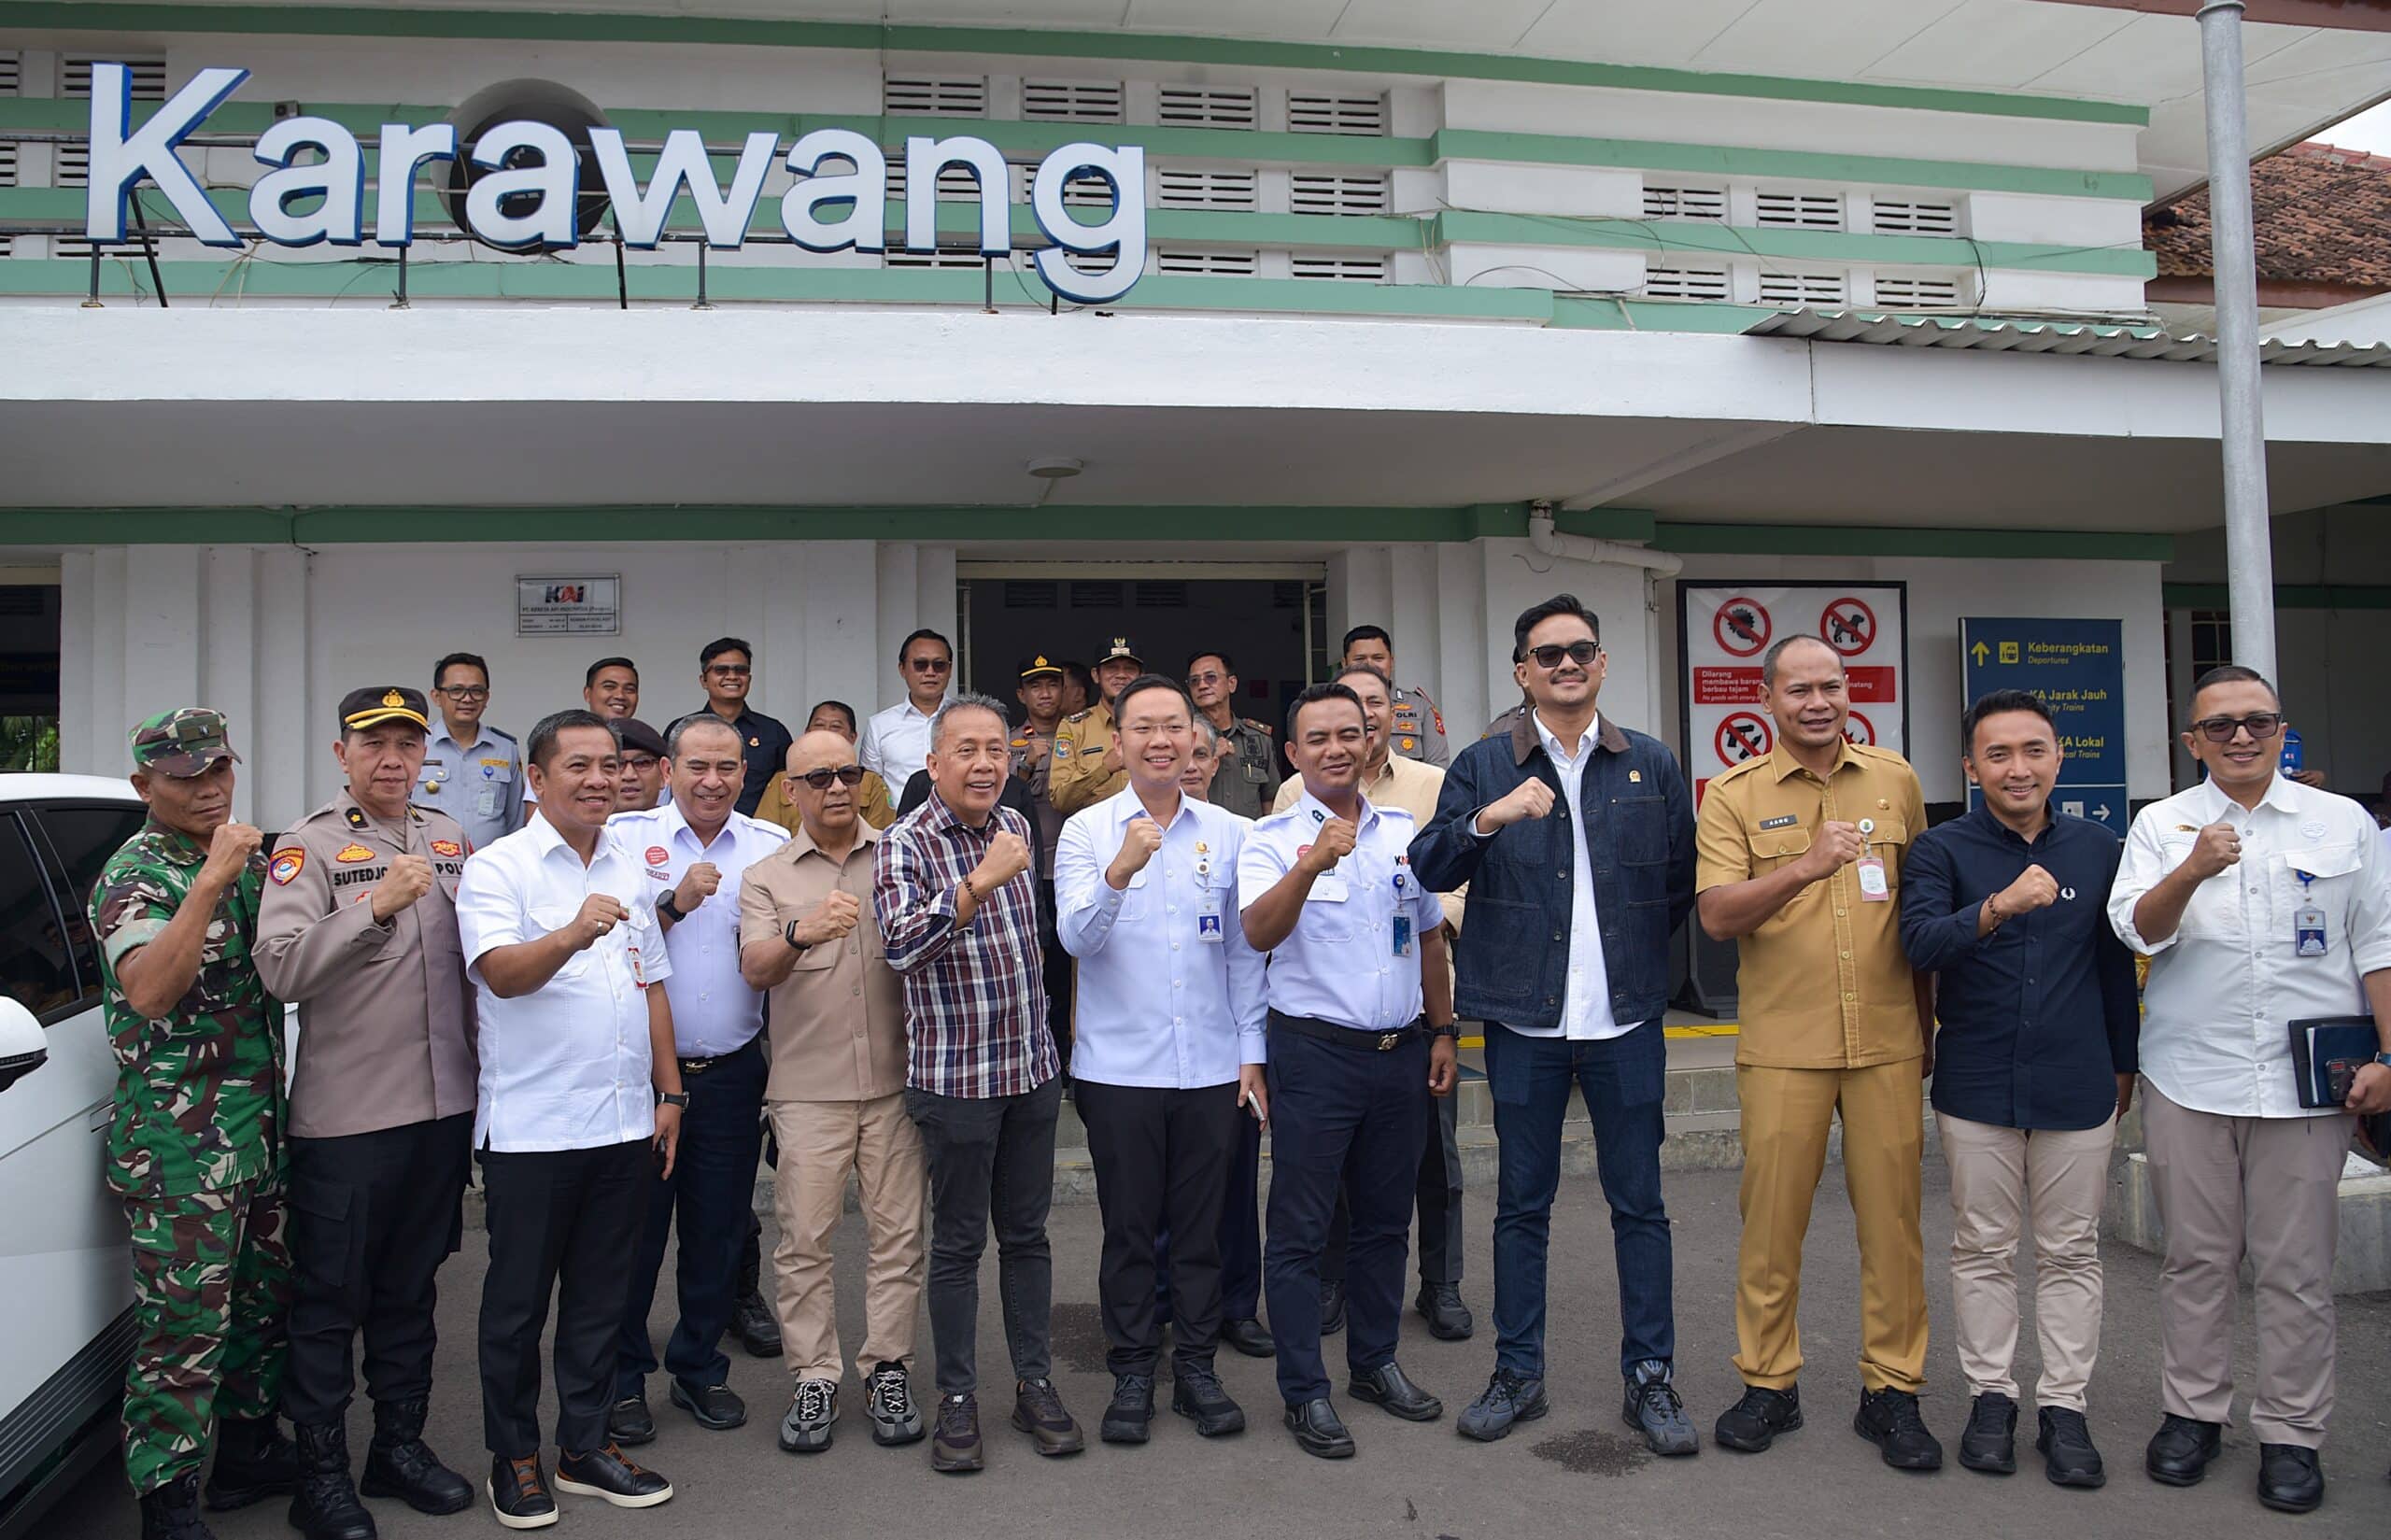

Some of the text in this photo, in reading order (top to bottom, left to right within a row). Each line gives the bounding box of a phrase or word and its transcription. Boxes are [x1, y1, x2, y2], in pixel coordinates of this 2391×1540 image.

[86, 62, 1147, 303] Karawang
[545, 586, 585, 603] KAI
[2028, 642, 2108, 655] Keberangkatan
[2028, 657, 2070, 665] Departures
[1702, 670, 1733, 679] Dilarang
[1849, 681, 1873, 689] natang
[2049, 689, 2078, 699] Jarak
[2081, 688, 2107, 699] Jauh
[2075, 736, 2104, 747] Lokal
